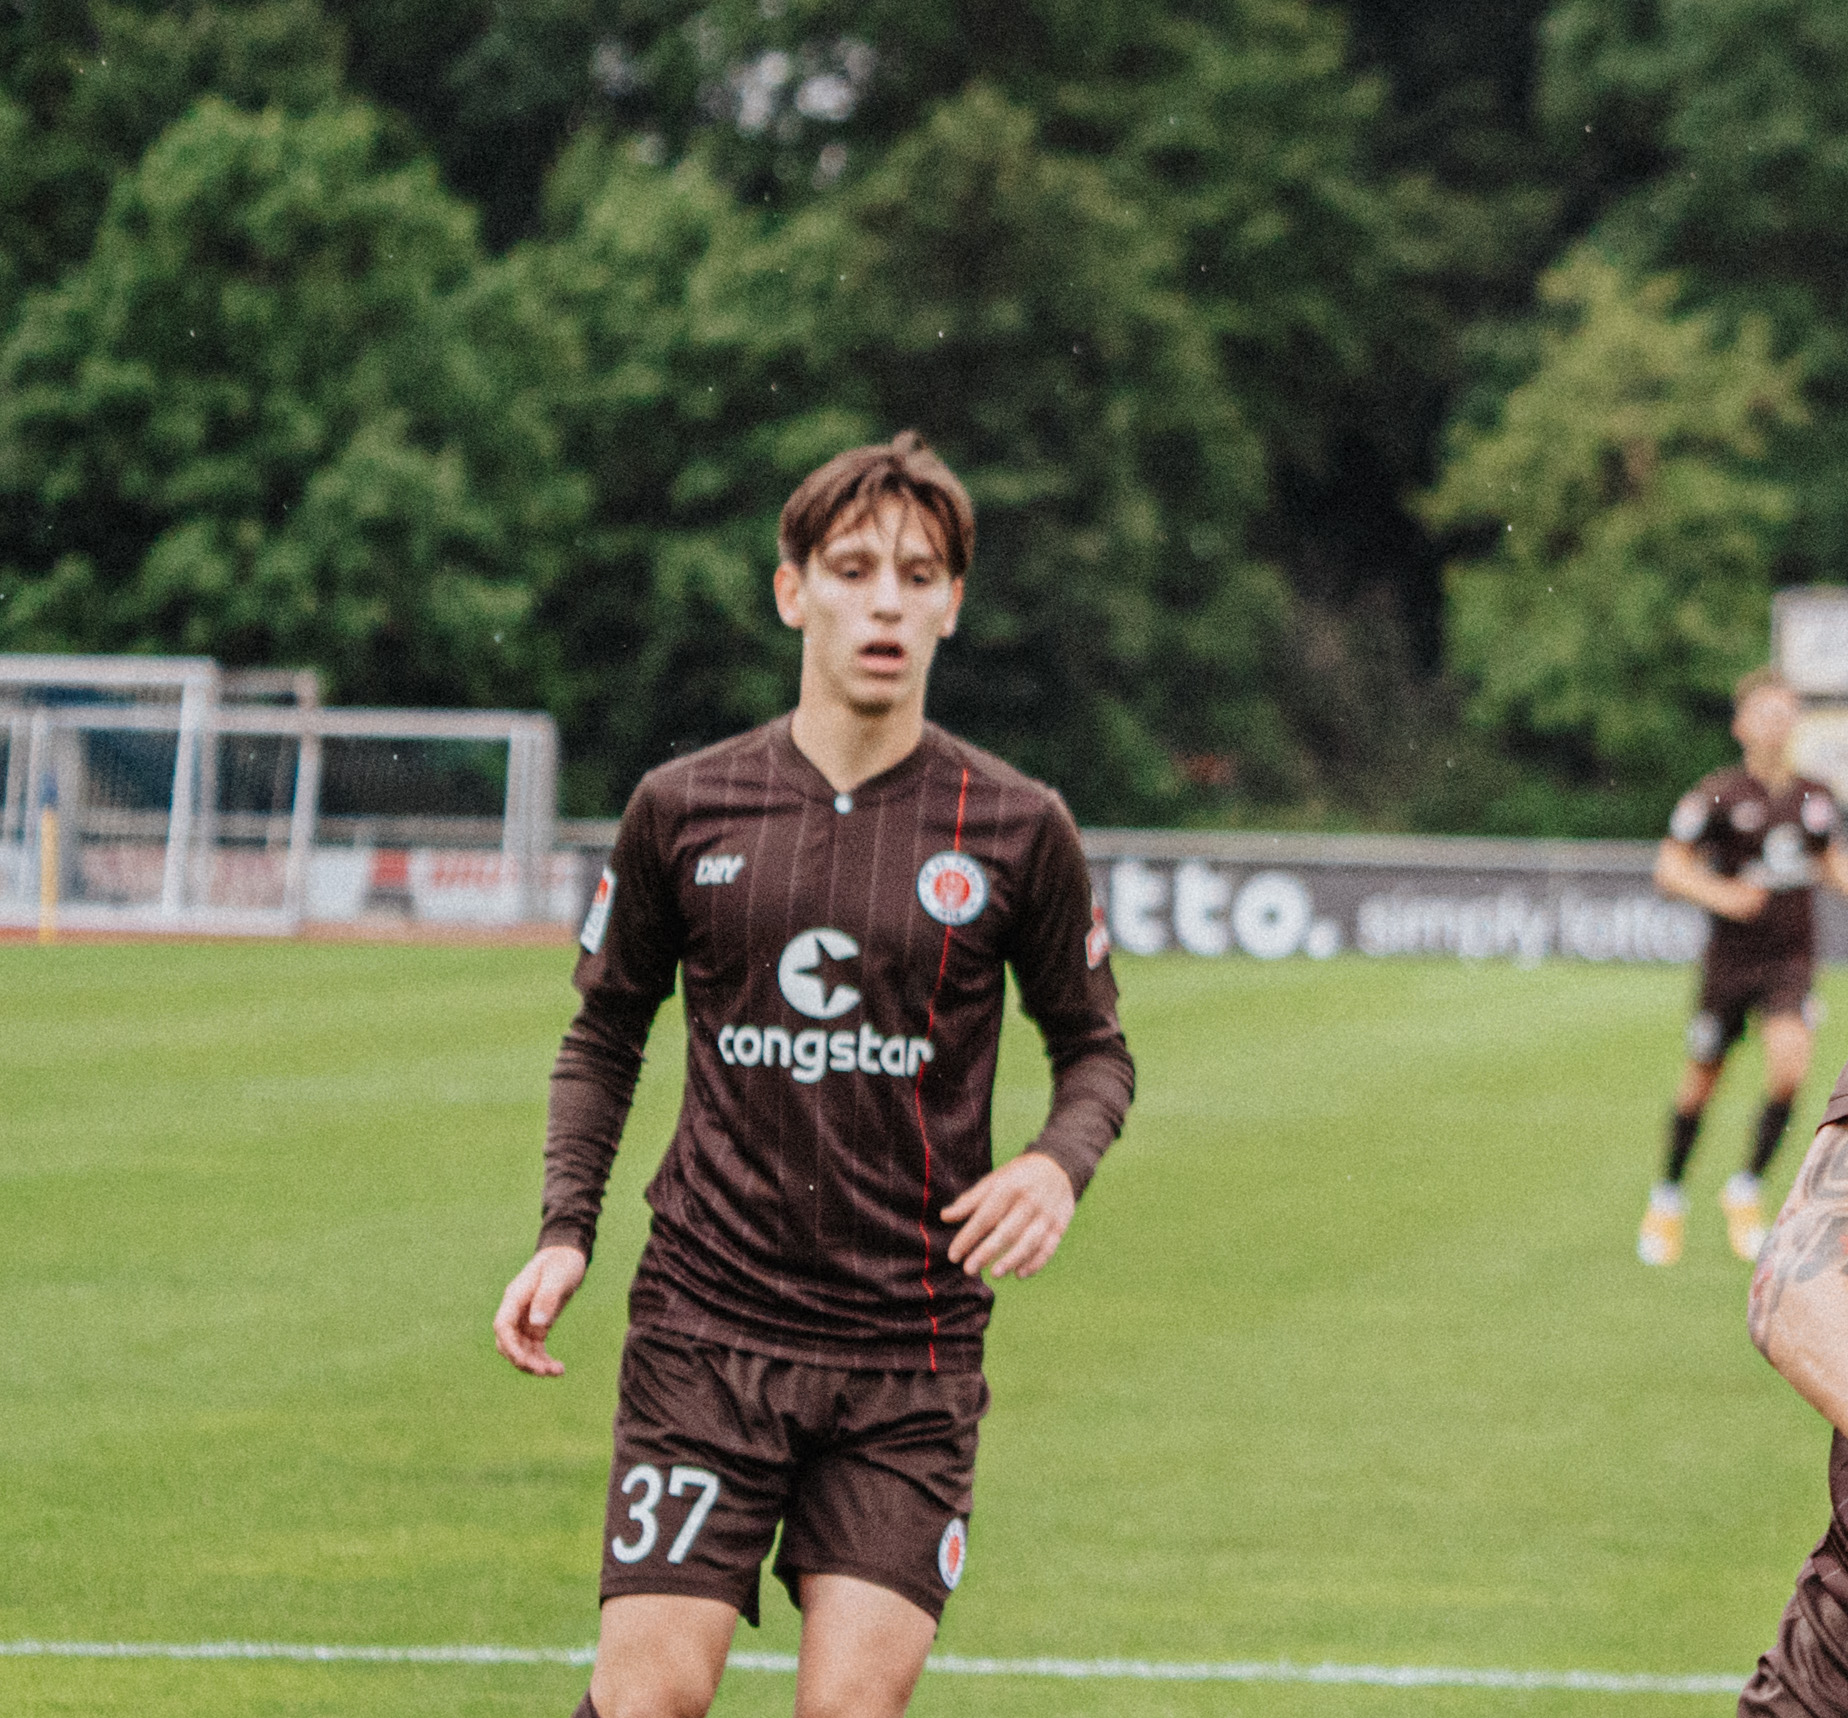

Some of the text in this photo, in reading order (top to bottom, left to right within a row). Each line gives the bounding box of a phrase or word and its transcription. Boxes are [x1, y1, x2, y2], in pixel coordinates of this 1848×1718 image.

[1110, 857, 1342, 960] tto.
[717, 1022, 935, 1084] congstar
[611, 1464, 719, 1564] 37
